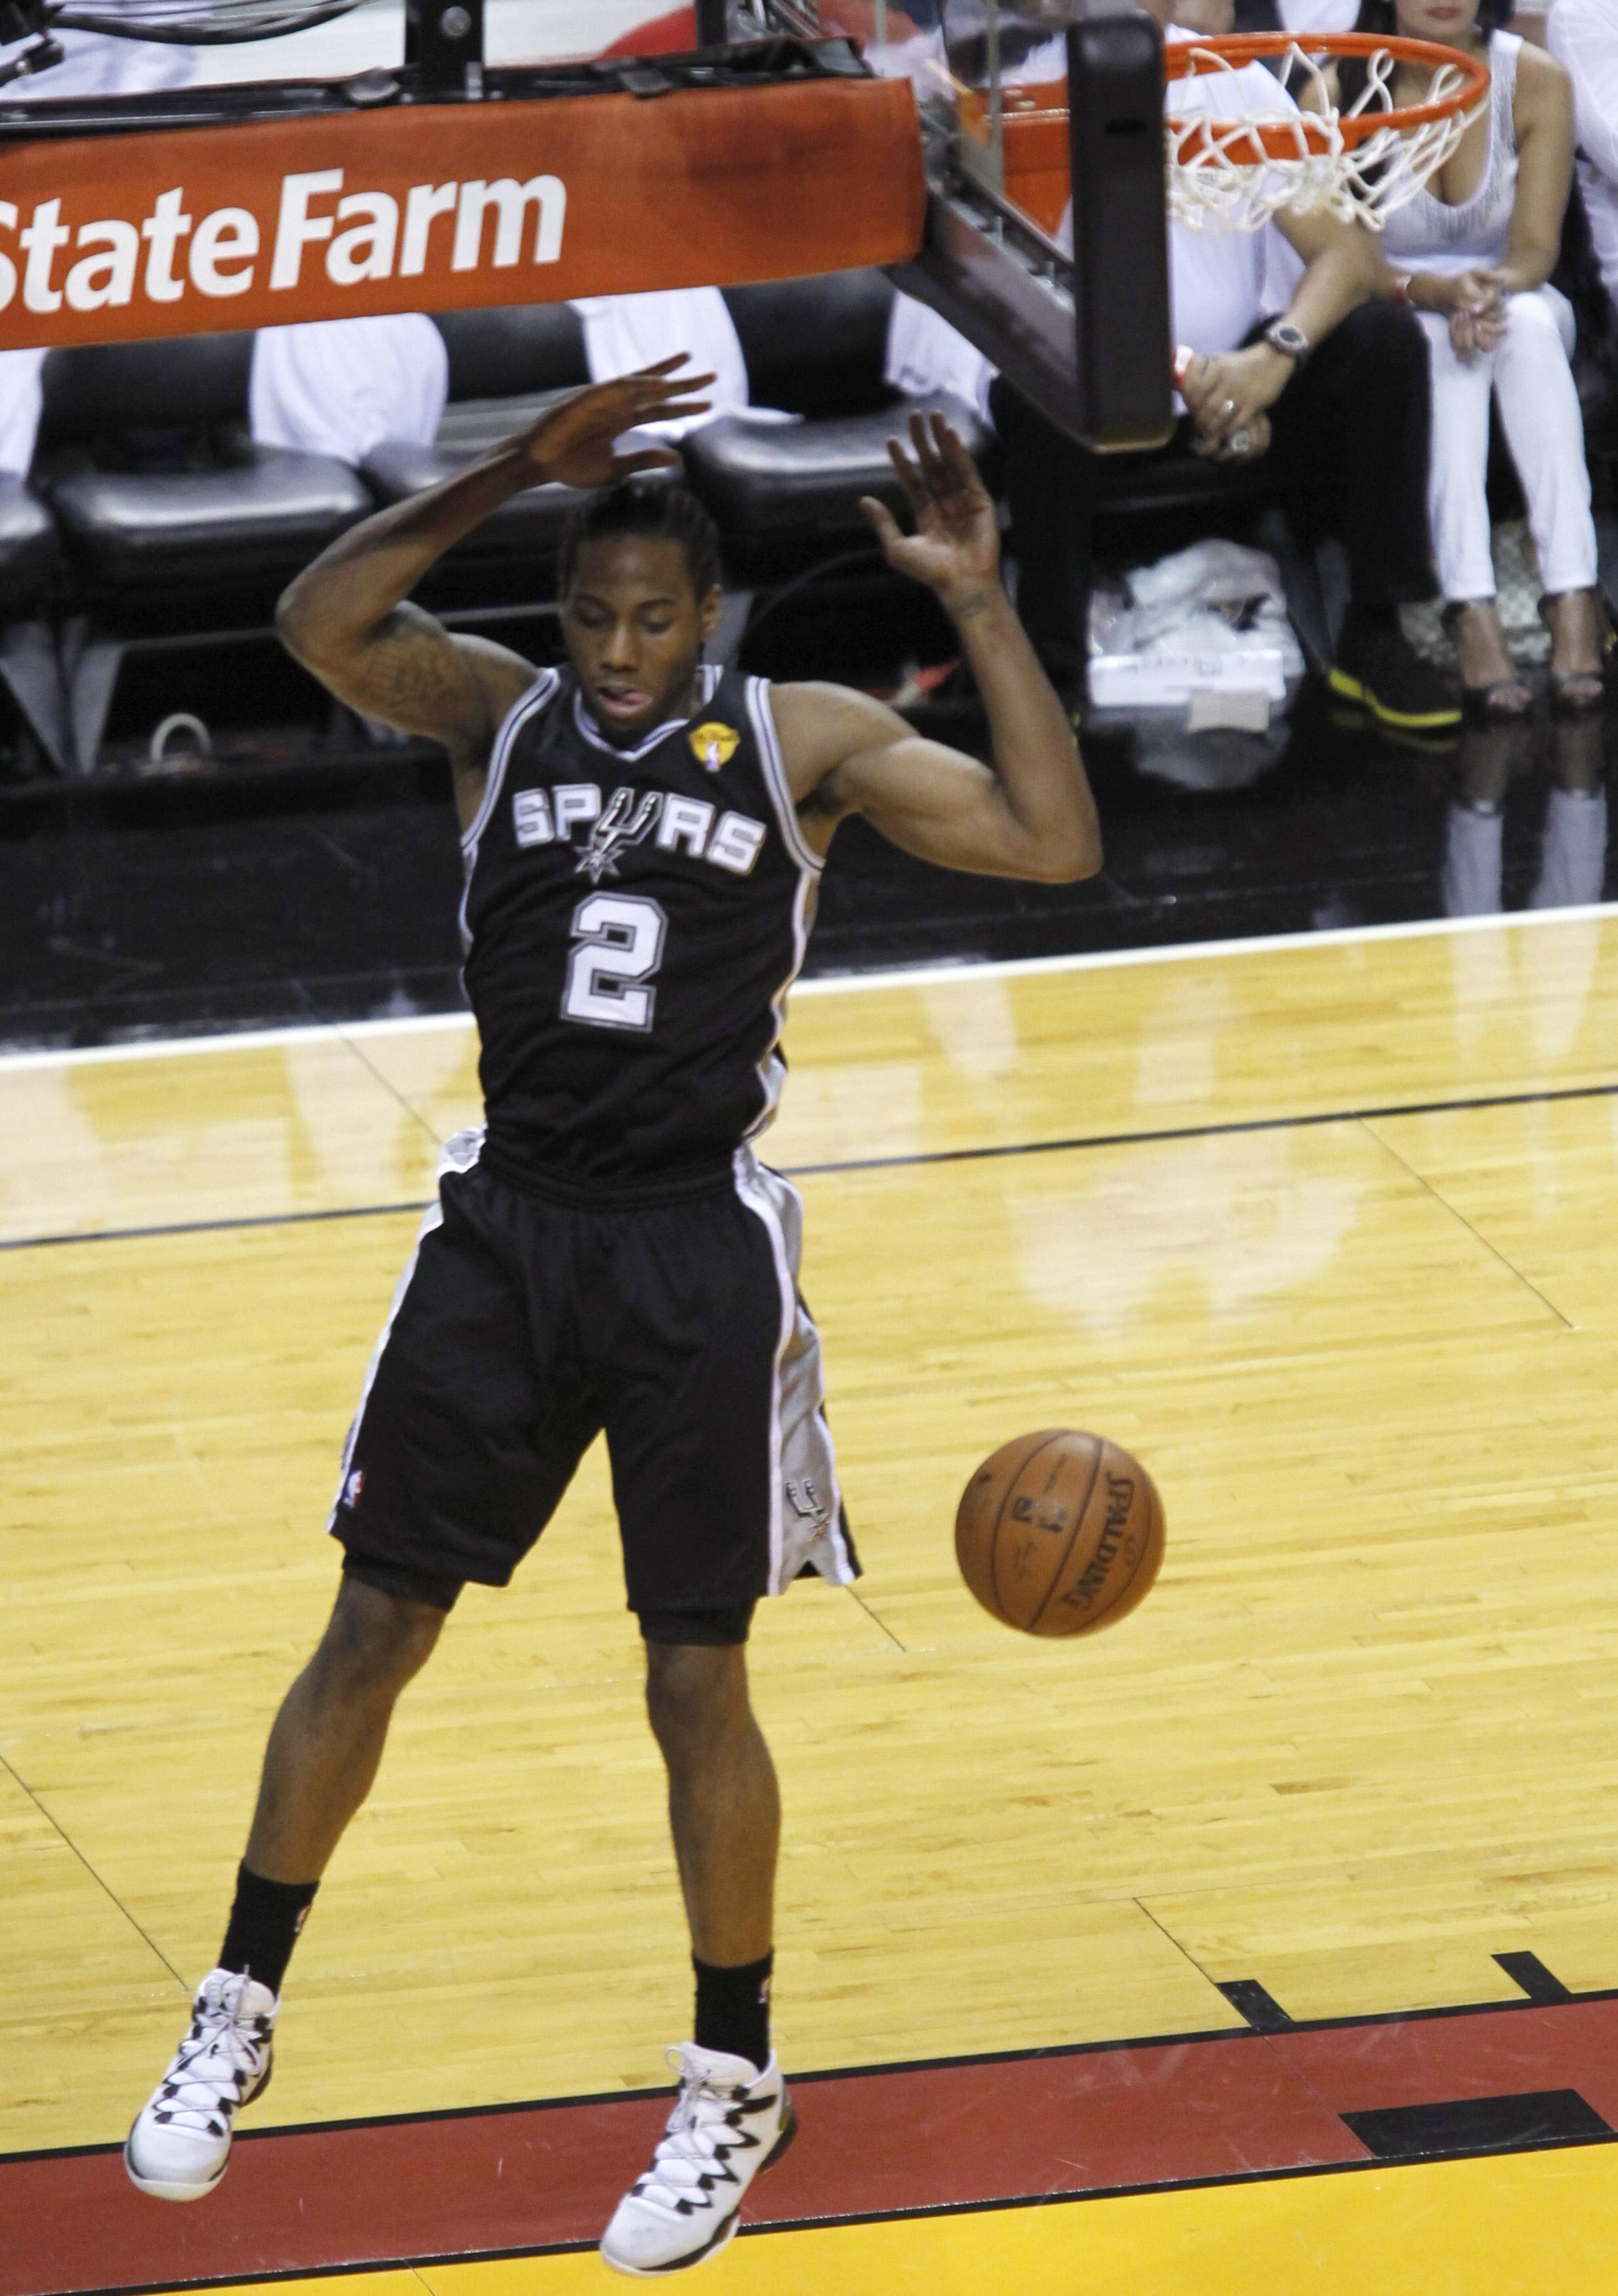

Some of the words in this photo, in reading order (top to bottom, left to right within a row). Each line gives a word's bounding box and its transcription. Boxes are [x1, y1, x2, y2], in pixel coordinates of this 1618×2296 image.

[512, 783, 767, 884] SPURS
[560, 890, 668, 1033] 2
[1062, 1469, 1134, 1610] SPALDING
